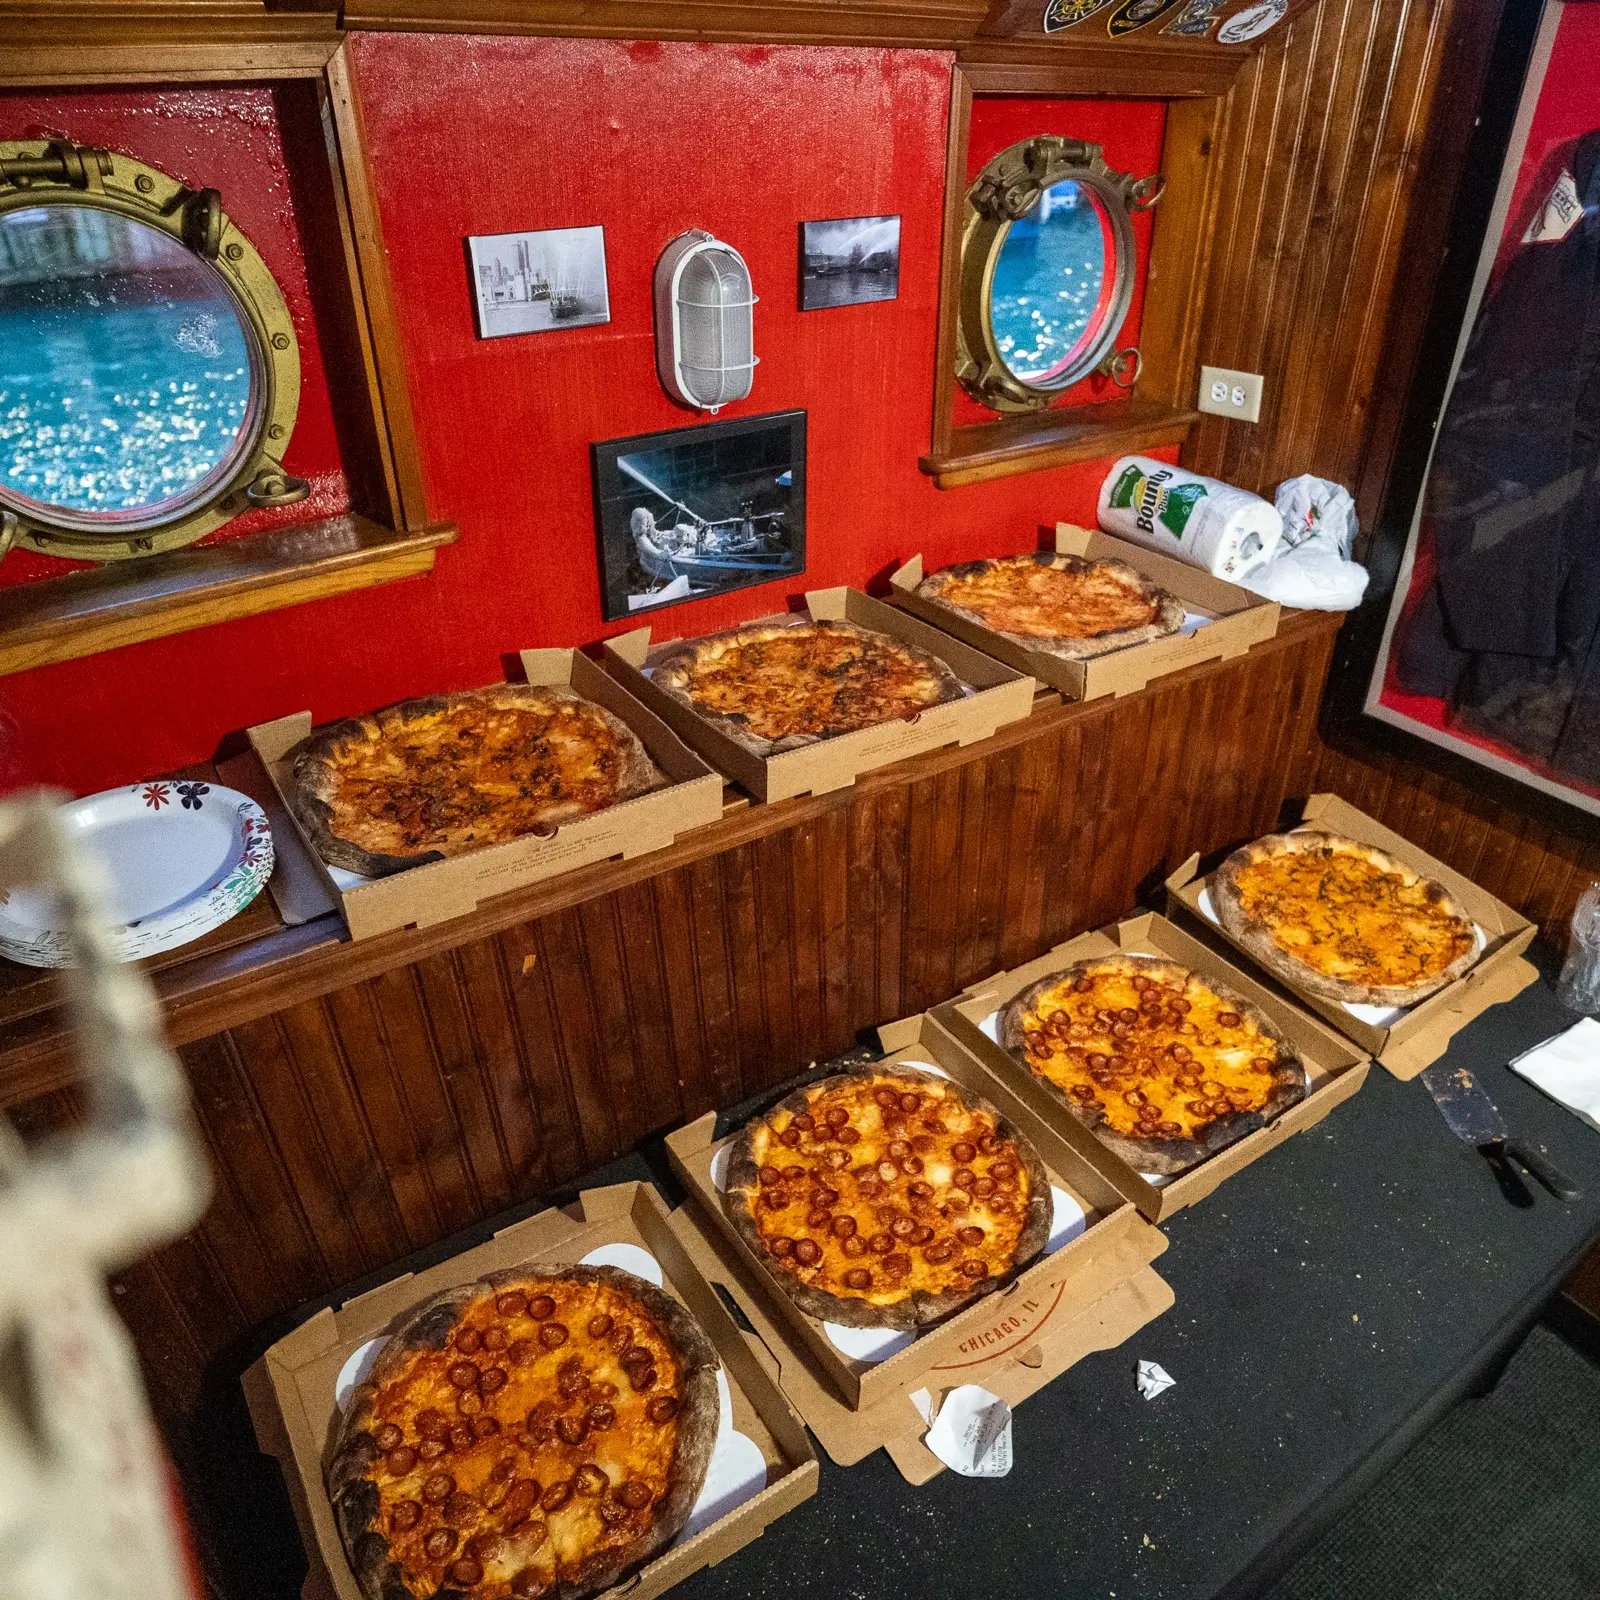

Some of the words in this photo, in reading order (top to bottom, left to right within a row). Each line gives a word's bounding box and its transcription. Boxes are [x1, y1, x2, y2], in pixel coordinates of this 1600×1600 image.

[1136, 469, 1173, 534] Bounty
[1157, 489, 1169, 512] Plus
[958, 1315, 1028, 1353] CHICAGO,
[1021, 1299, 1040, 1313] IL
